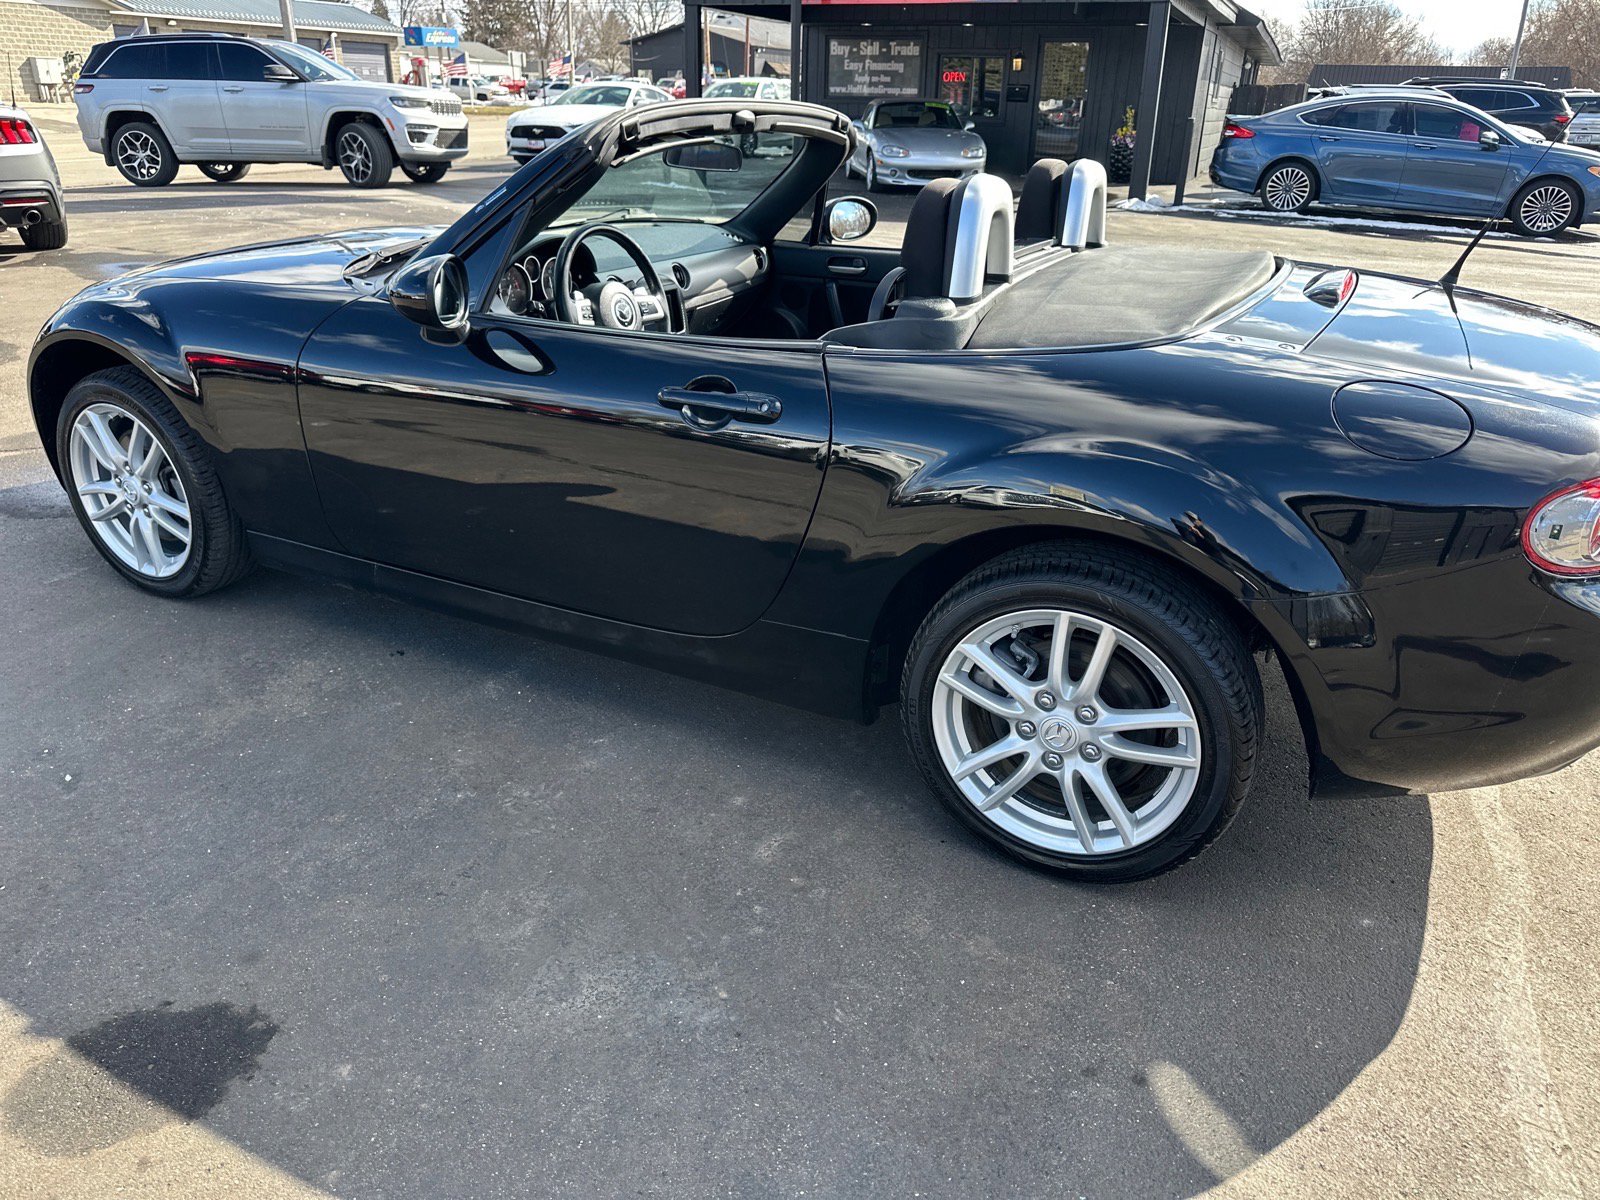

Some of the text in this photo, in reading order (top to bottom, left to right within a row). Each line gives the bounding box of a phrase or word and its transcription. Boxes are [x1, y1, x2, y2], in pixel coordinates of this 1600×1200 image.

[425, 33, 456, 45] Express
[830, 41, 850, 57] Buy
[860, 41, 880, 56] Sell
[889, 41, 920, 56] Trade
[844, 59, 904, 73] Easy Financing
[854, 74, 870, 83] Apply
[942, 71, 966, 82] OPEN
